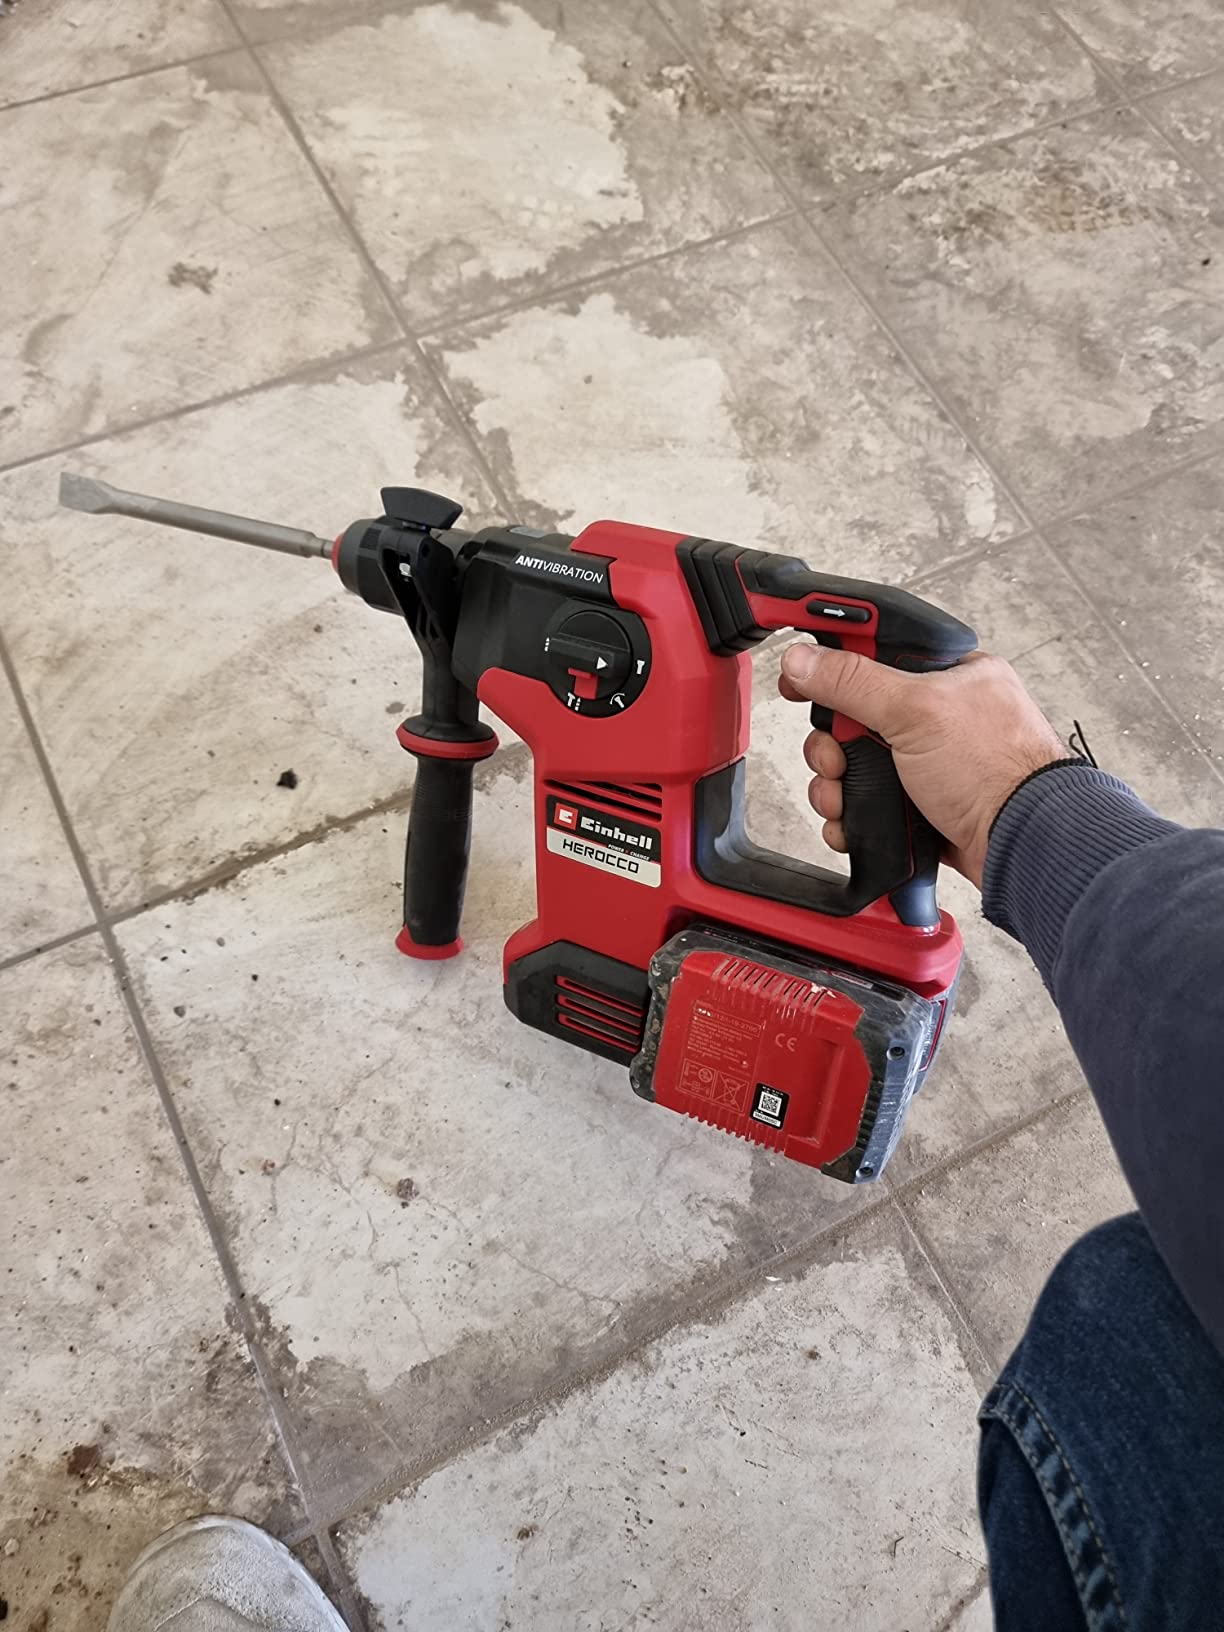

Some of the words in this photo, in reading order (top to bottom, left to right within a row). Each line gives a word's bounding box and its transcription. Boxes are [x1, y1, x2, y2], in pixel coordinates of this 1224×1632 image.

[515, 555, 603, 583] ANTIVIBRATION
[581, 816, 653, 850] Einhell
[562, 838, 639, 873] HEROCCO
